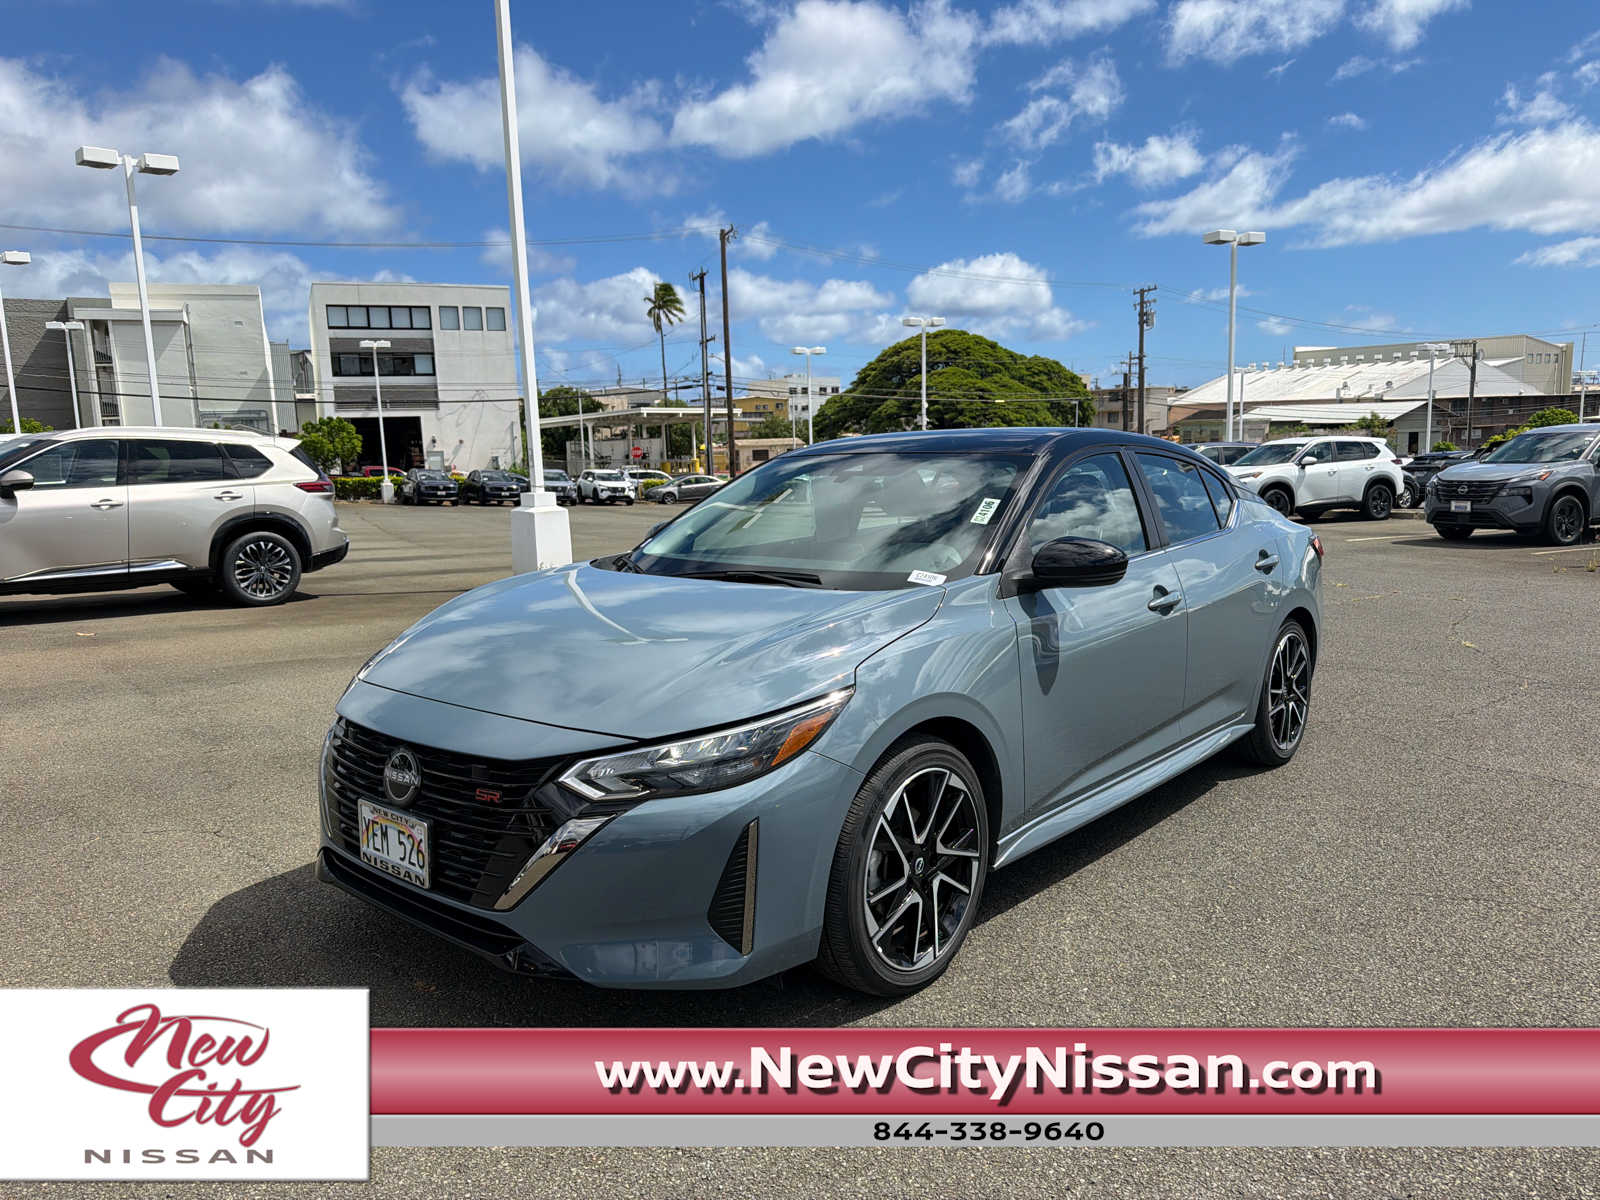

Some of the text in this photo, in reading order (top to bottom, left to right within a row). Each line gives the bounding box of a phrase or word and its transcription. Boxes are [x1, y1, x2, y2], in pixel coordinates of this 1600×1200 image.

[384, 767, 421, 785] NISSAN
[475, 788, 500, 803] SR
[371, 806, 410, 825] NEW CITY
[363, 815, 425, 870] YEM 526
[362, 852, 425, 886] NISSAN
